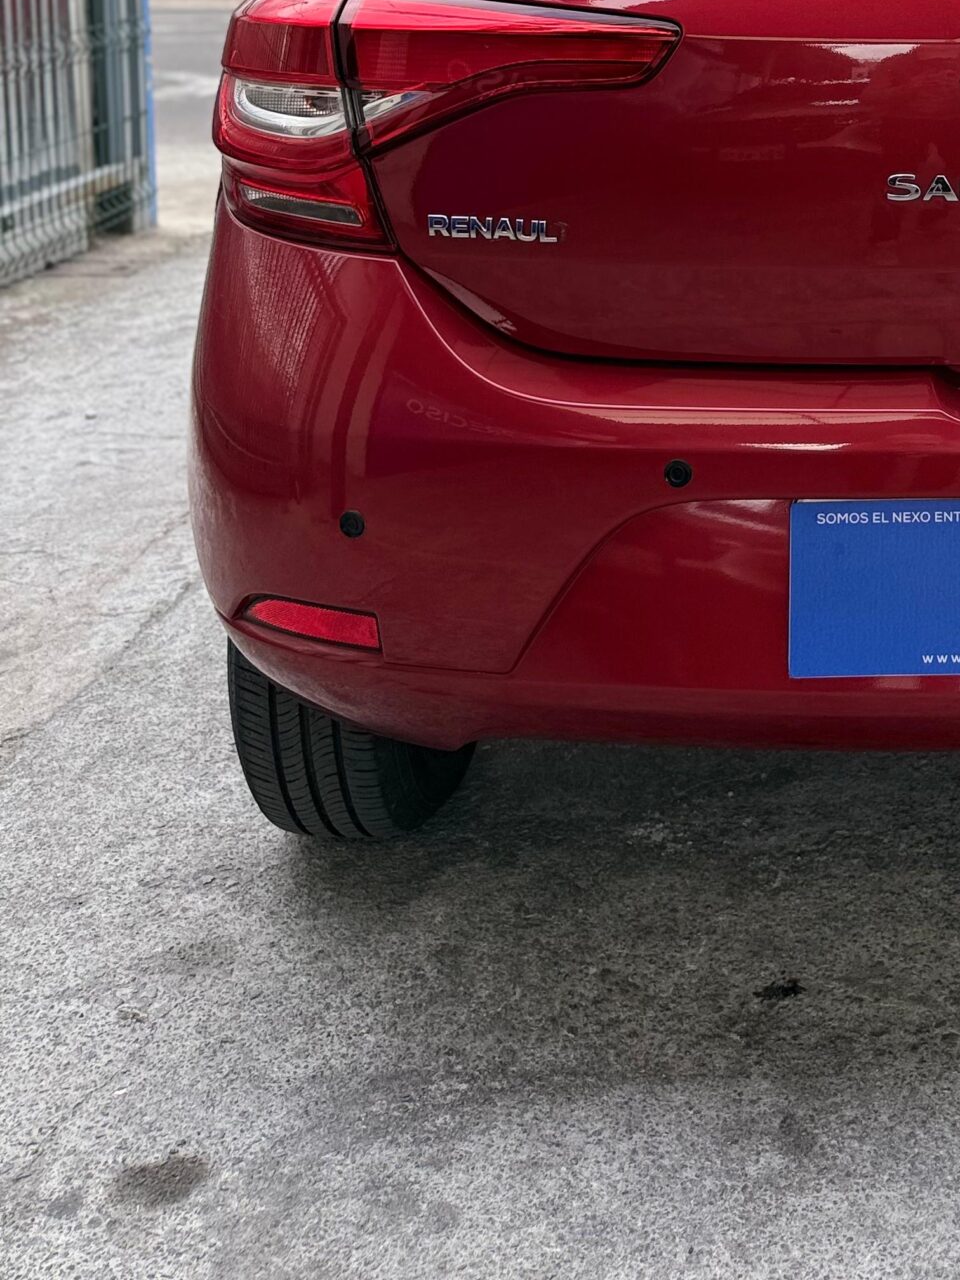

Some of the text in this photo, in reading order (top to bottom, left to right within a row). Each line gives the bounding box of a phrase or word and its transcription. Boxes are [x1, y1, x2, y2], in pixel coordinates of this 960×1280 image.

[816, 512, 869, 525] SOMOS
[872, 512, 889, 524] EL
[892, 511, 931, 523] NEXO
